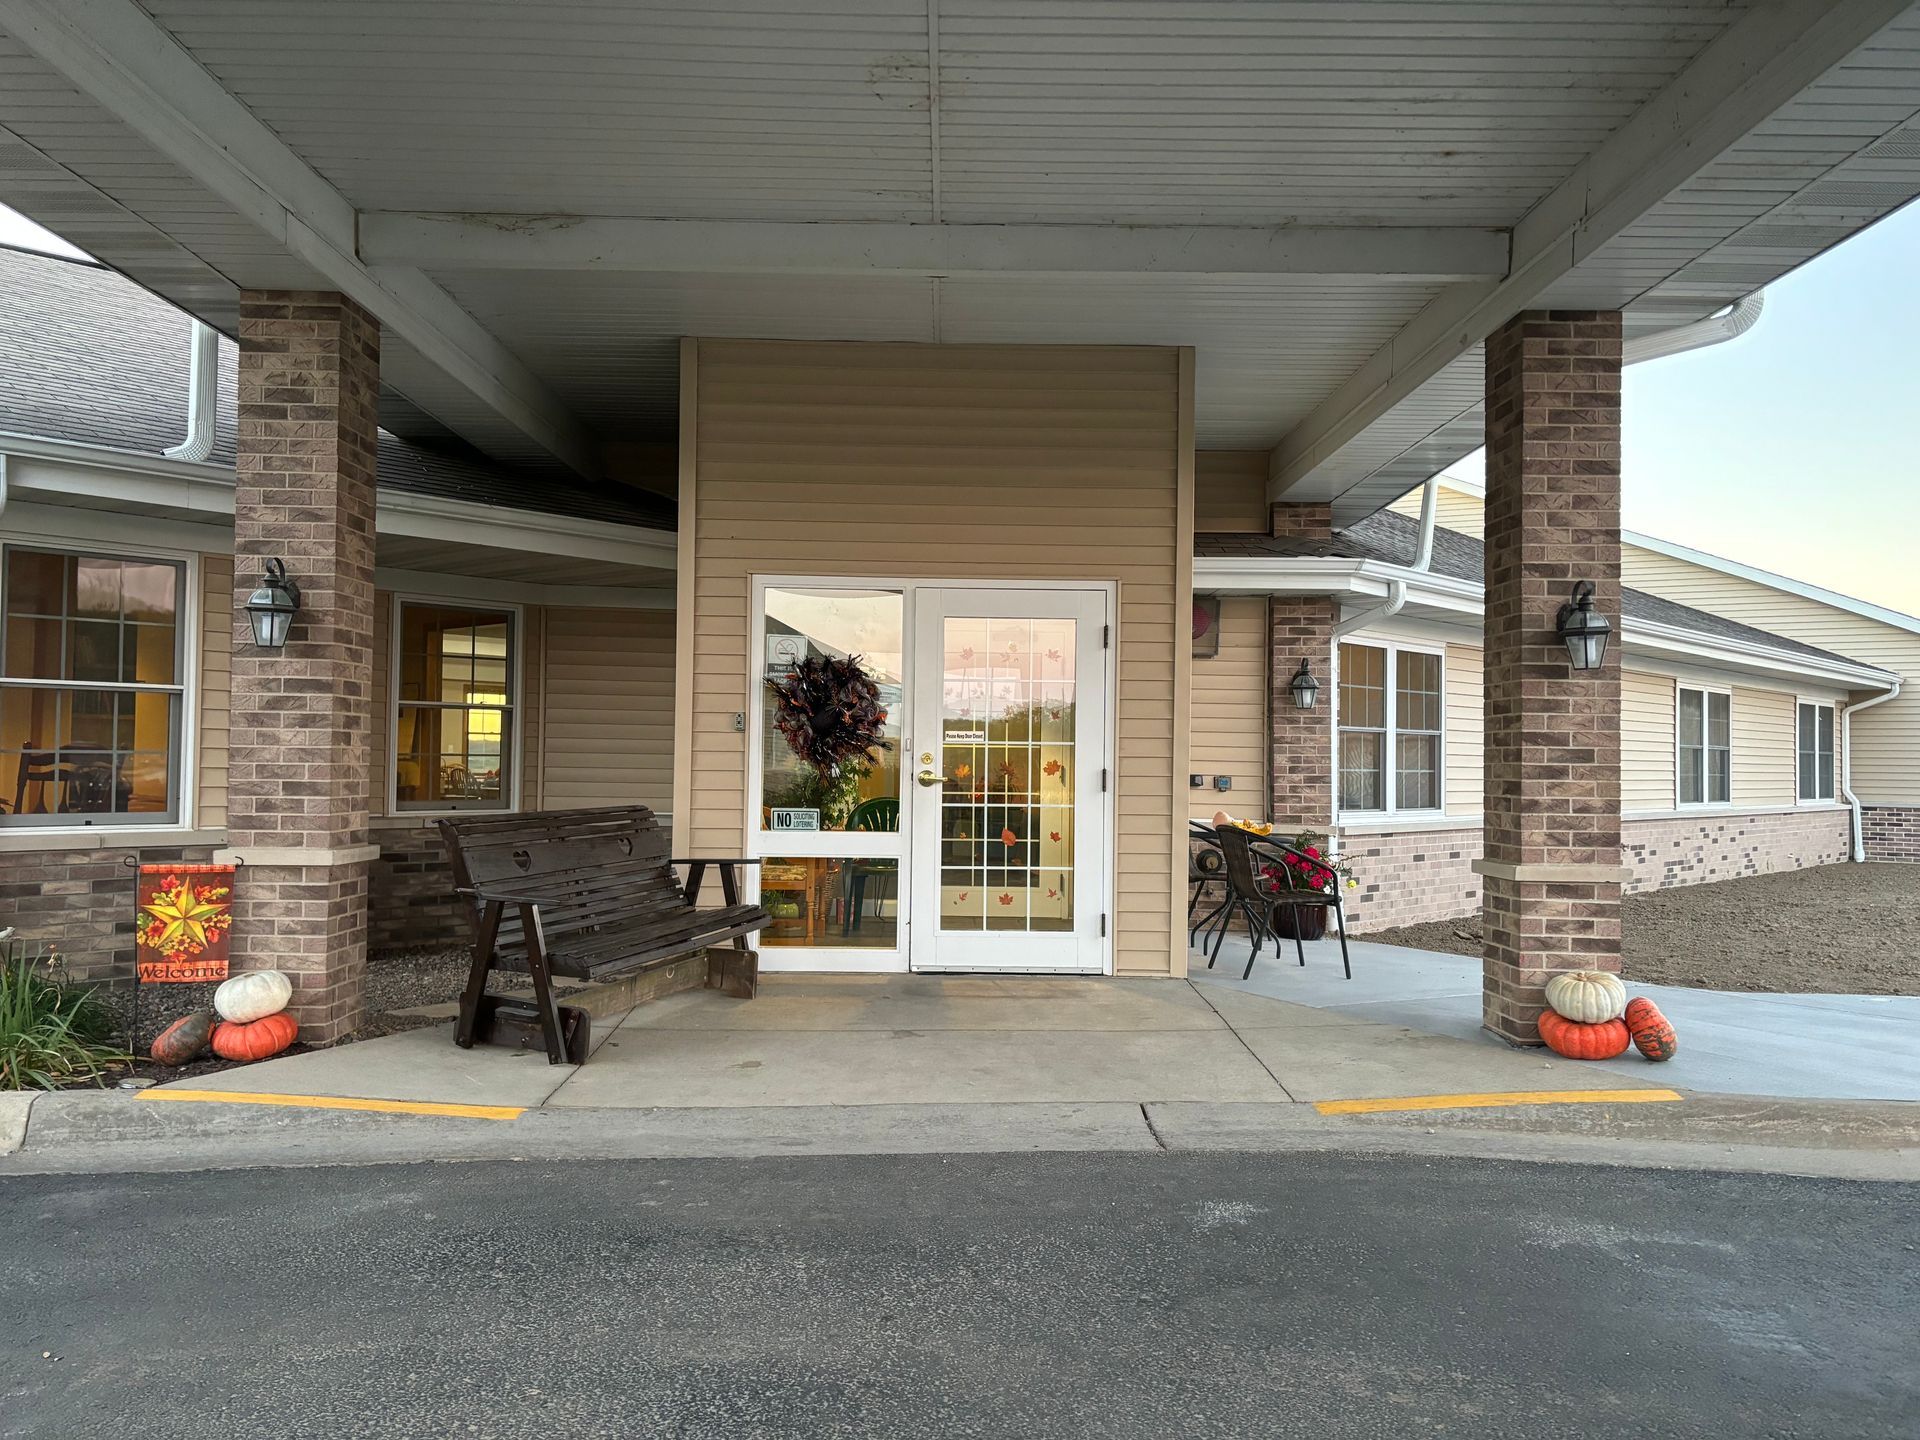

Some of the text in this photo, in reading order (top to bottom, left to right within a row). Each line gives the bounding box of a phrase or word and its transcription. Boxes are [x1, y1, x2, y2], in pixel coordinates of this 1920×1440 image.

[777, 812, 791, 828] NO
[793, 812, 815, 820] SOLICITING
[139, 965, 226, 979] Welcome
